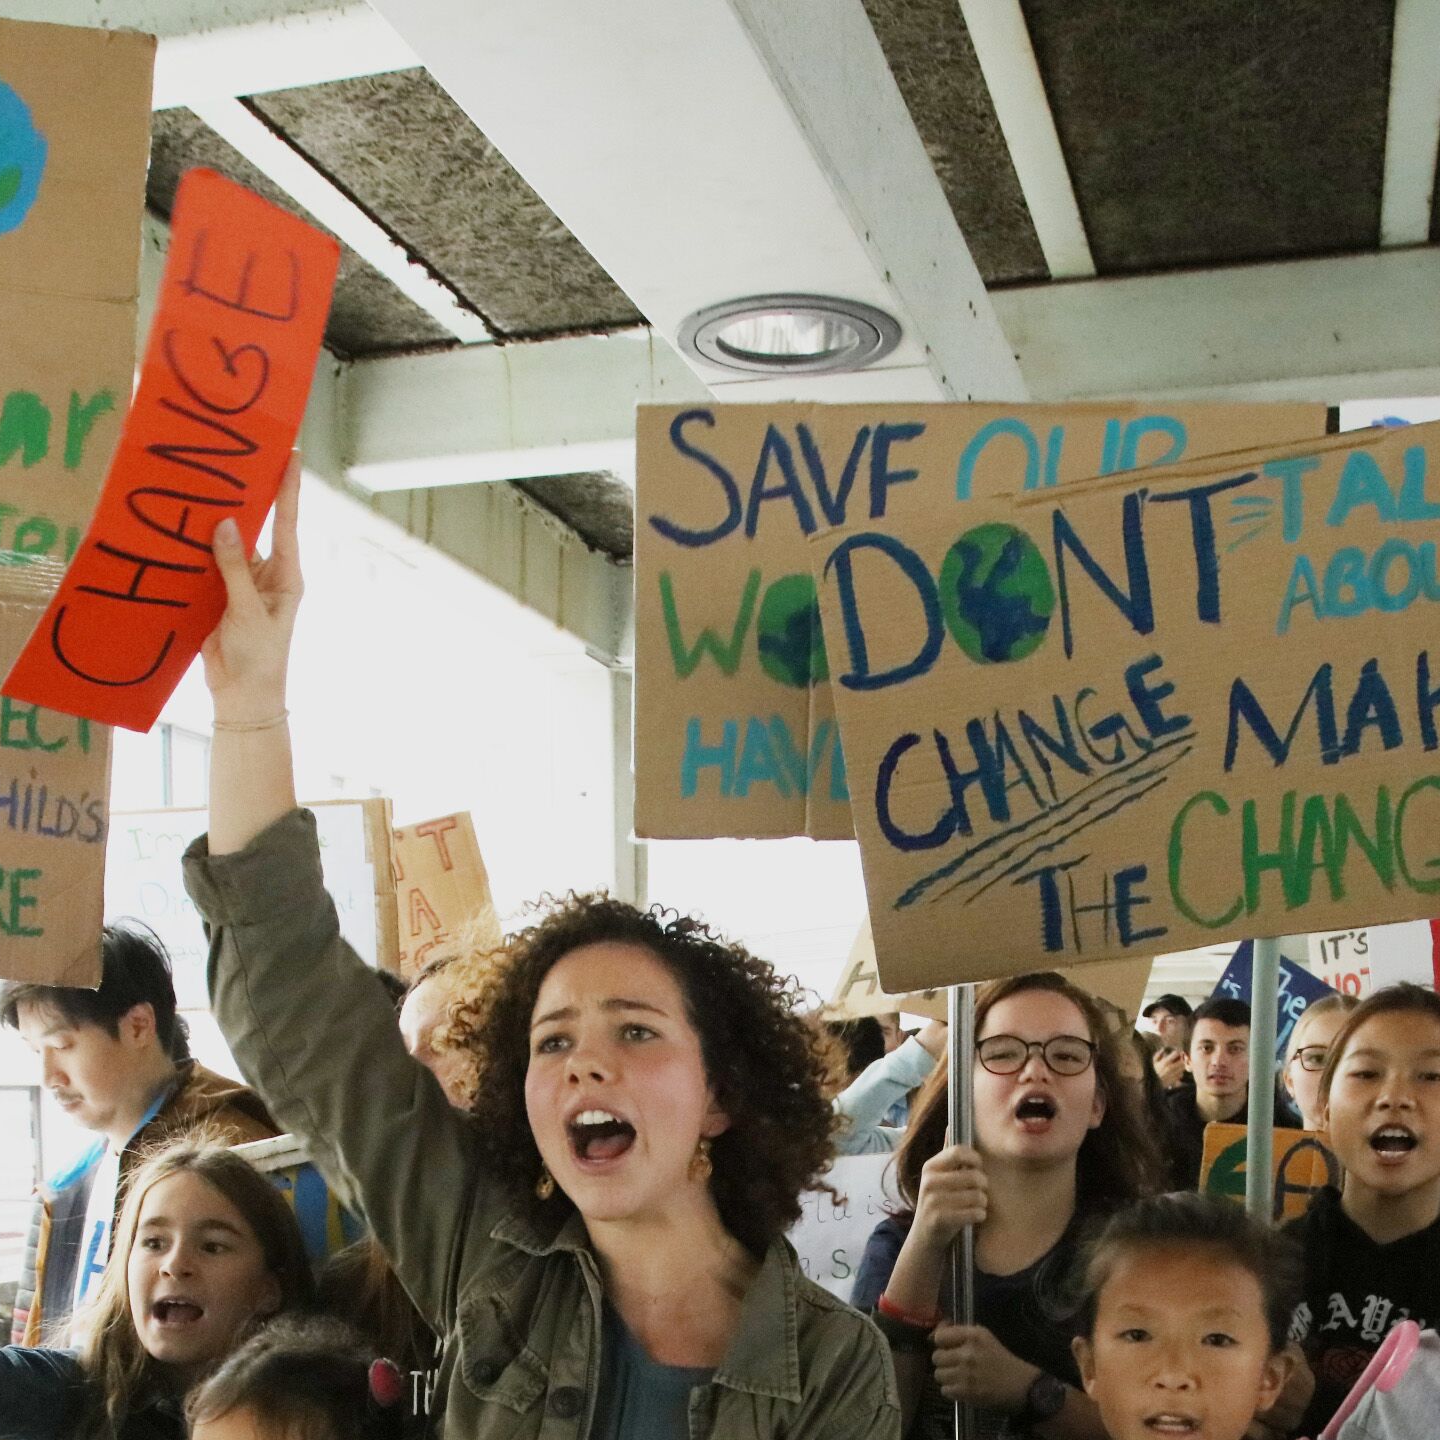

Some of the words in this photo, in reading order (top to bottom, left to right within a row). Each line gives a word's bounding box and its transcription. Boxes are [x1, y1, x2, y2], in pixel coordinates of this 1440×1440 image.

[52, 229, 300, 687] CHANGE
[874, 654, 1194, 852] CHANGE
[1012, 852, 1168, 954] THE
[1320, 931, 1368, 965] IT'S
